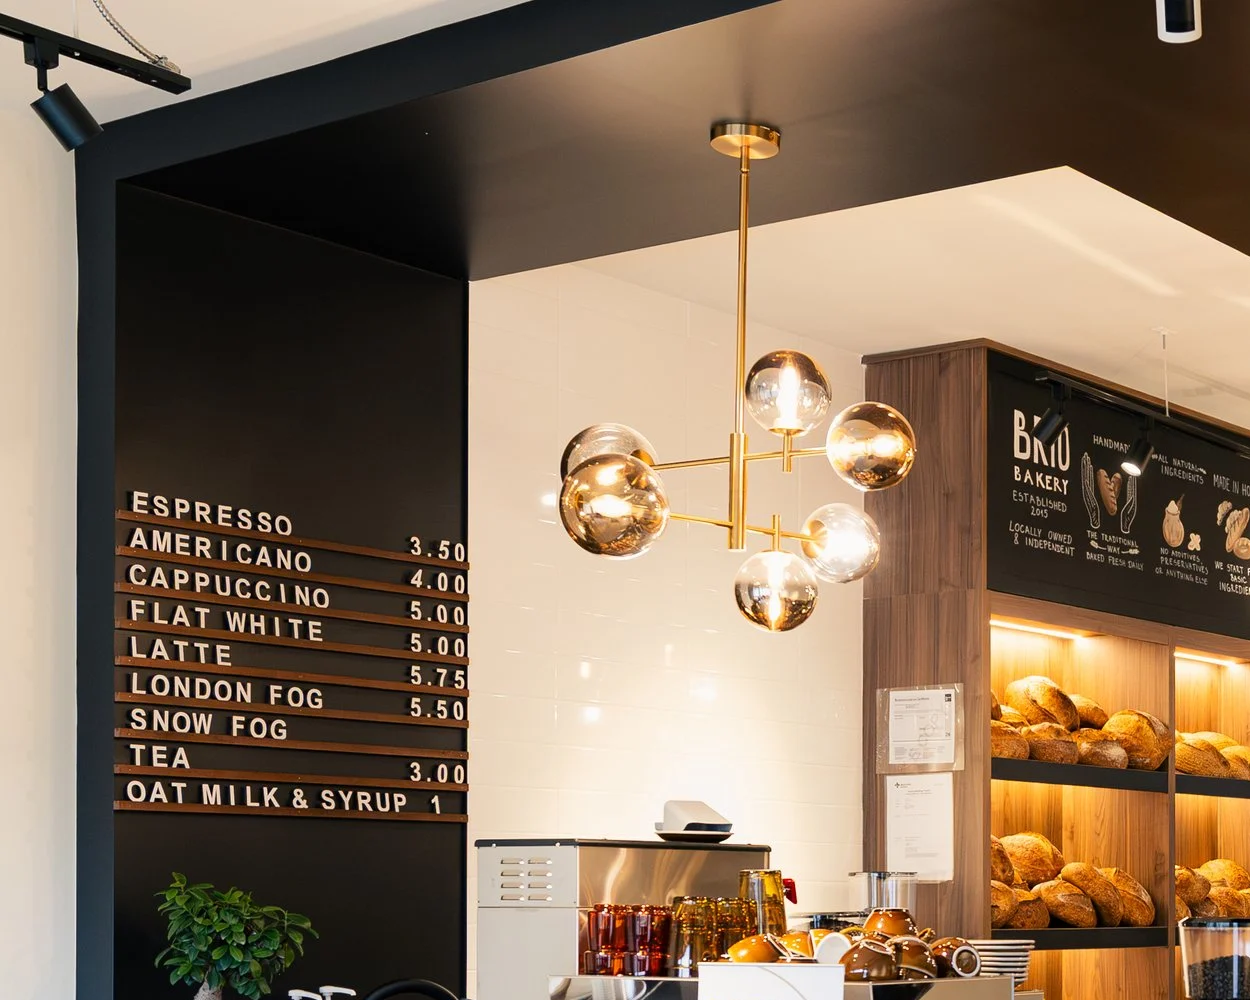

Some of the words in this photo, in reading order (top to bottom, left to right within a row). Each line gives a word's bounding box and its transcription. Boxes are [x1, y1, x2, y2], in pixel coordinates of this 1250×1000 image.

[1158, 454, 1168, 464] ALL
[1173, 458, 1198, 472] NATURAL
[1014, 465, 1069, 495] BAKERY
[1161, 465, 1204, 485] INGREDIENTS
[1213, 474, 1230, 492] MADE
[1232, 480, 1239, 494] IN
[1012, 489, 1067, 512] ESTABLISHED
[1030, 506, 1049, 518] 2015
[132, 491, 293, 536] ESPRESSO
[410, 536, 465, 563] 3.50
[1009, 520, 1042, 537] LOCALLY
[1048, 530, 1073, 544] OWNED
[1014, 532, 1019, 545] &
[1025, 537, 1075, 556] INDEPENDENT
[1086, 530, 1098, 540] THE
[1101, 533, 1139, 548] TRADITIONAL
[1107, 545, 1120, 554] WAY
[130, 527, 312, 573] AMERICANO
[410, 569, 465, 595] 4.00
[1086, 551, 1105, 562] BAKED
[1108, 556, 1126, 567] FRESH
[1128, 560, 1144, 571] DAILY
[1160, 556, 1208, 575] PRESERVATIVES
[1215, 561, 1223, 570] WE
[1226, 563, 1243, 574] START
[1165, 568, 1194, 582] ANYTHING
[1195, 576, 1208, 586] ELSE
[1230, 573, 1247, 584] BASIC
[129, 564, 330, 609] CAPPUCCINO
[410, 601, 465, 626] 5.00
[130, 600, 211, 629] FLAT
[226, 610, 324, 642] WHITE
[410, 633, 465, 658] 5.00
[130, 636, 232, 667] LATTE
[410, 666, 465, 690] 5.75
[131, 672, 252, 704] LONDON
[269, 684, 324, 710] FOG
[410, 698, 465, 721] 5.50
[130, 708, 212, 735] SNOW
[231, 715, 288, 740] FOG
[129, 743, 190, 770] TEA
[410, 762, 465, 785] 3.00
[126, 780, 186, 804] OAT
[202, 783, 280, 808] MILK
[292, 788, 309, 809] &
[321, 789, 407, 813] SYRUP
[430, 794, 441, 815] 1
